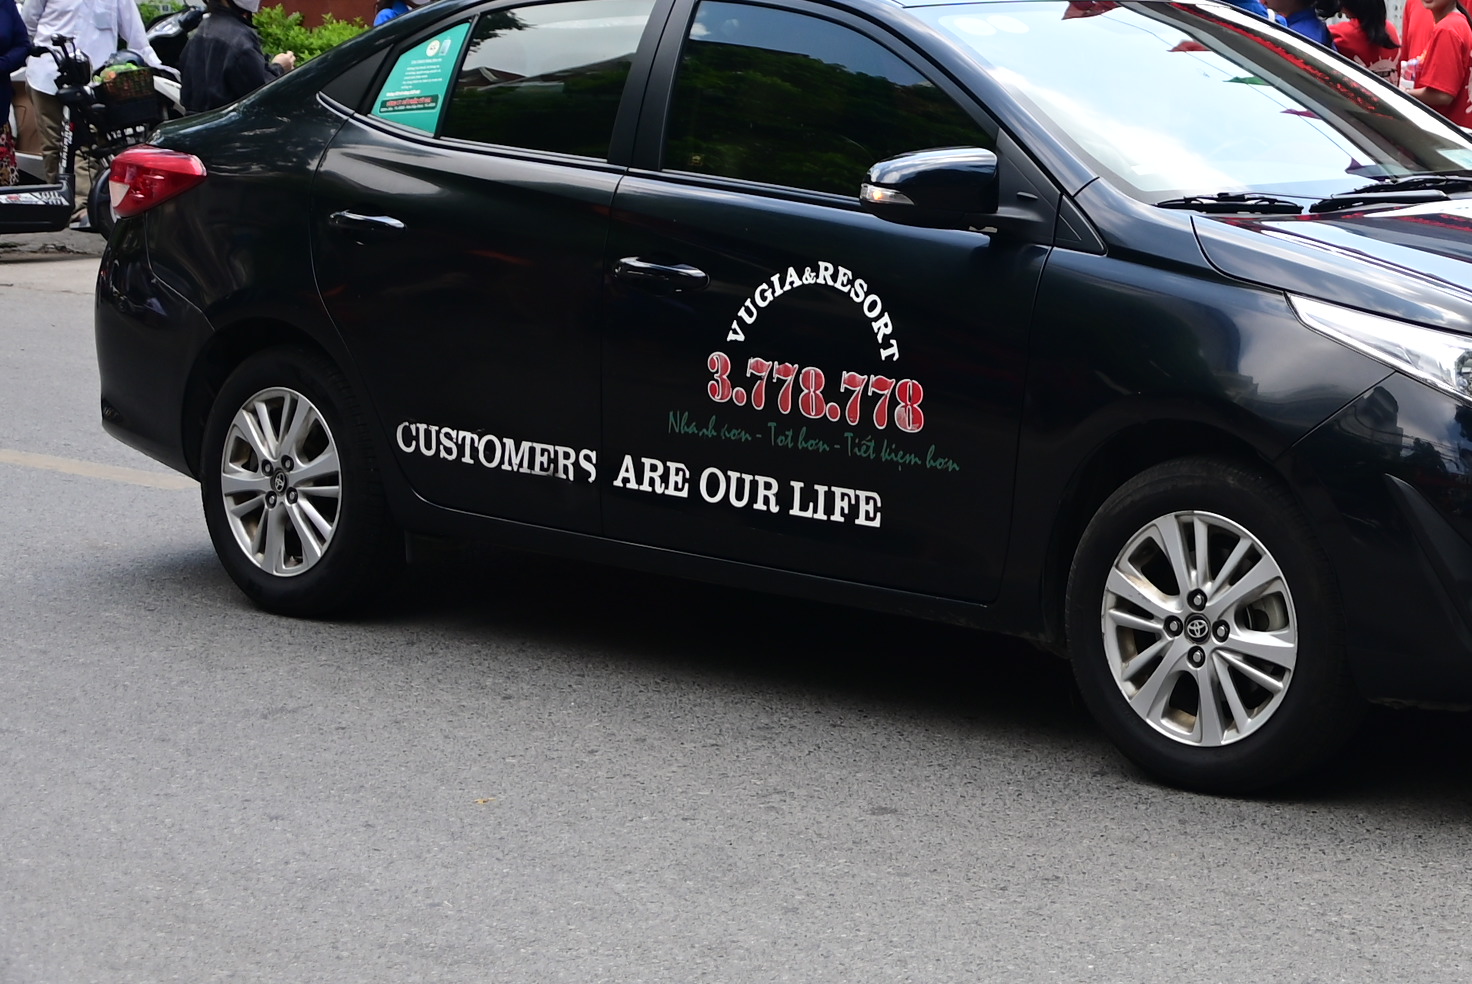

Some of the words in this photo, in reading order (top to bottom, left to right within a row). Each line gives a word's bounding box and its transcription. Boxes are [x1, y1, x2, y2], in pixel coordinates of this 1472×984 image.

[727, 260, 901, 362] VUGIA&RESORT
[707, 351, 925, 433] 3.778.778
[395, 420, 598, 484] CUSTOMERS
[613, 454, 690, 499] ARE
[700, 467, 780, 514] OUR
[789, 480, 883, 529] LIFE
[668, 411, 717, 437] Nhanh
[798, 426, 830, 452] hơn
[844, 432, 876, 459] Tiết
[926, 444, 960, 472] hơn
